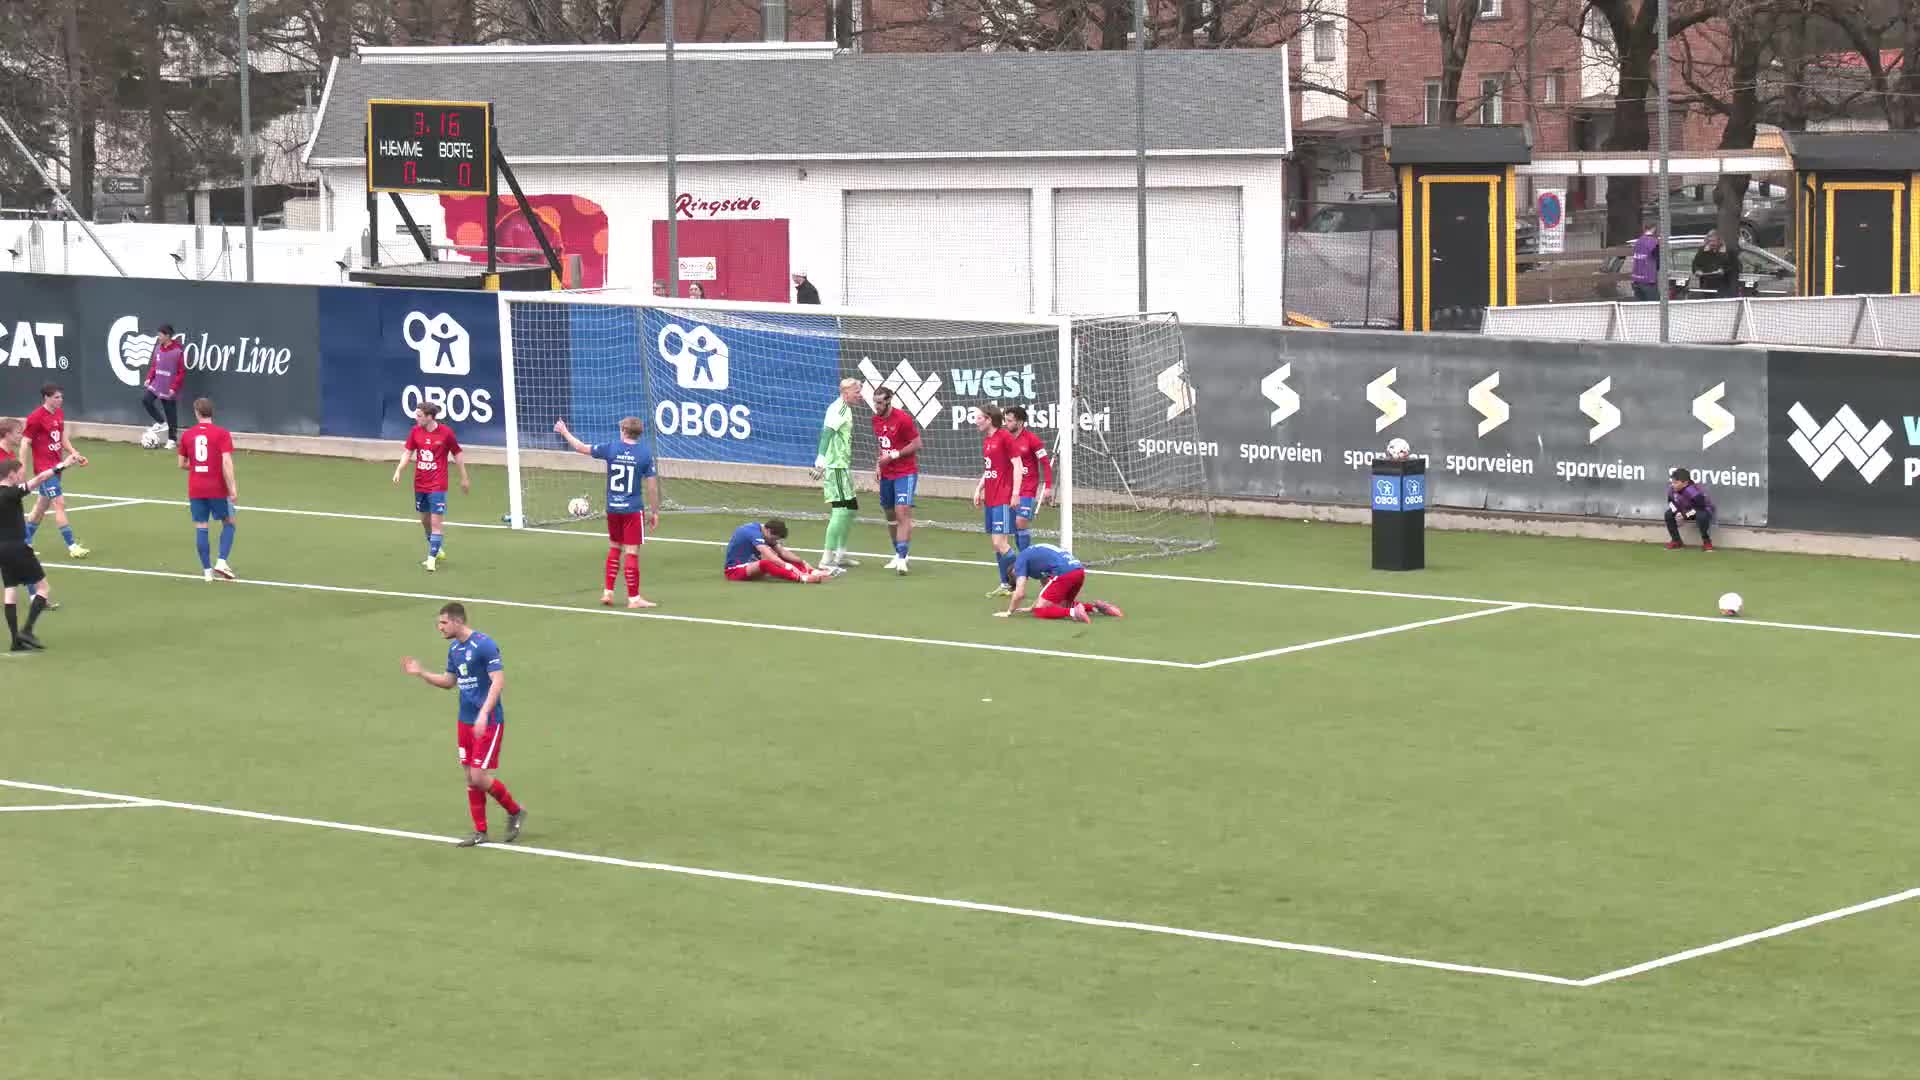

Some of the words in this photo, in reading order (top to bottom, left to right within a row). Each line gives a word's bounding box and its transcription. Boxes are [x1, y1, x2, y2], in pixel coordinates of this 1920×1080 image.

[379, 140, 423, 157] HJEMME
[439, 142, 473, 158] BORTE
[675, 193, 761, 218] Ringside
[235, 337, 291, 375] Line
[951, 364, 1036, 399] west
[656, 399, 750, 440] OBOS
[195, 435, 208, 462] 6
[1138, 438, 1218, 457] sporveien
[1240, 442, 1322, 463] sporveien
[1446, 453, 1534, 475] sporveien
[1556, 459, 1645, 481] sporveien
[610, 463, 635, 494] 21
